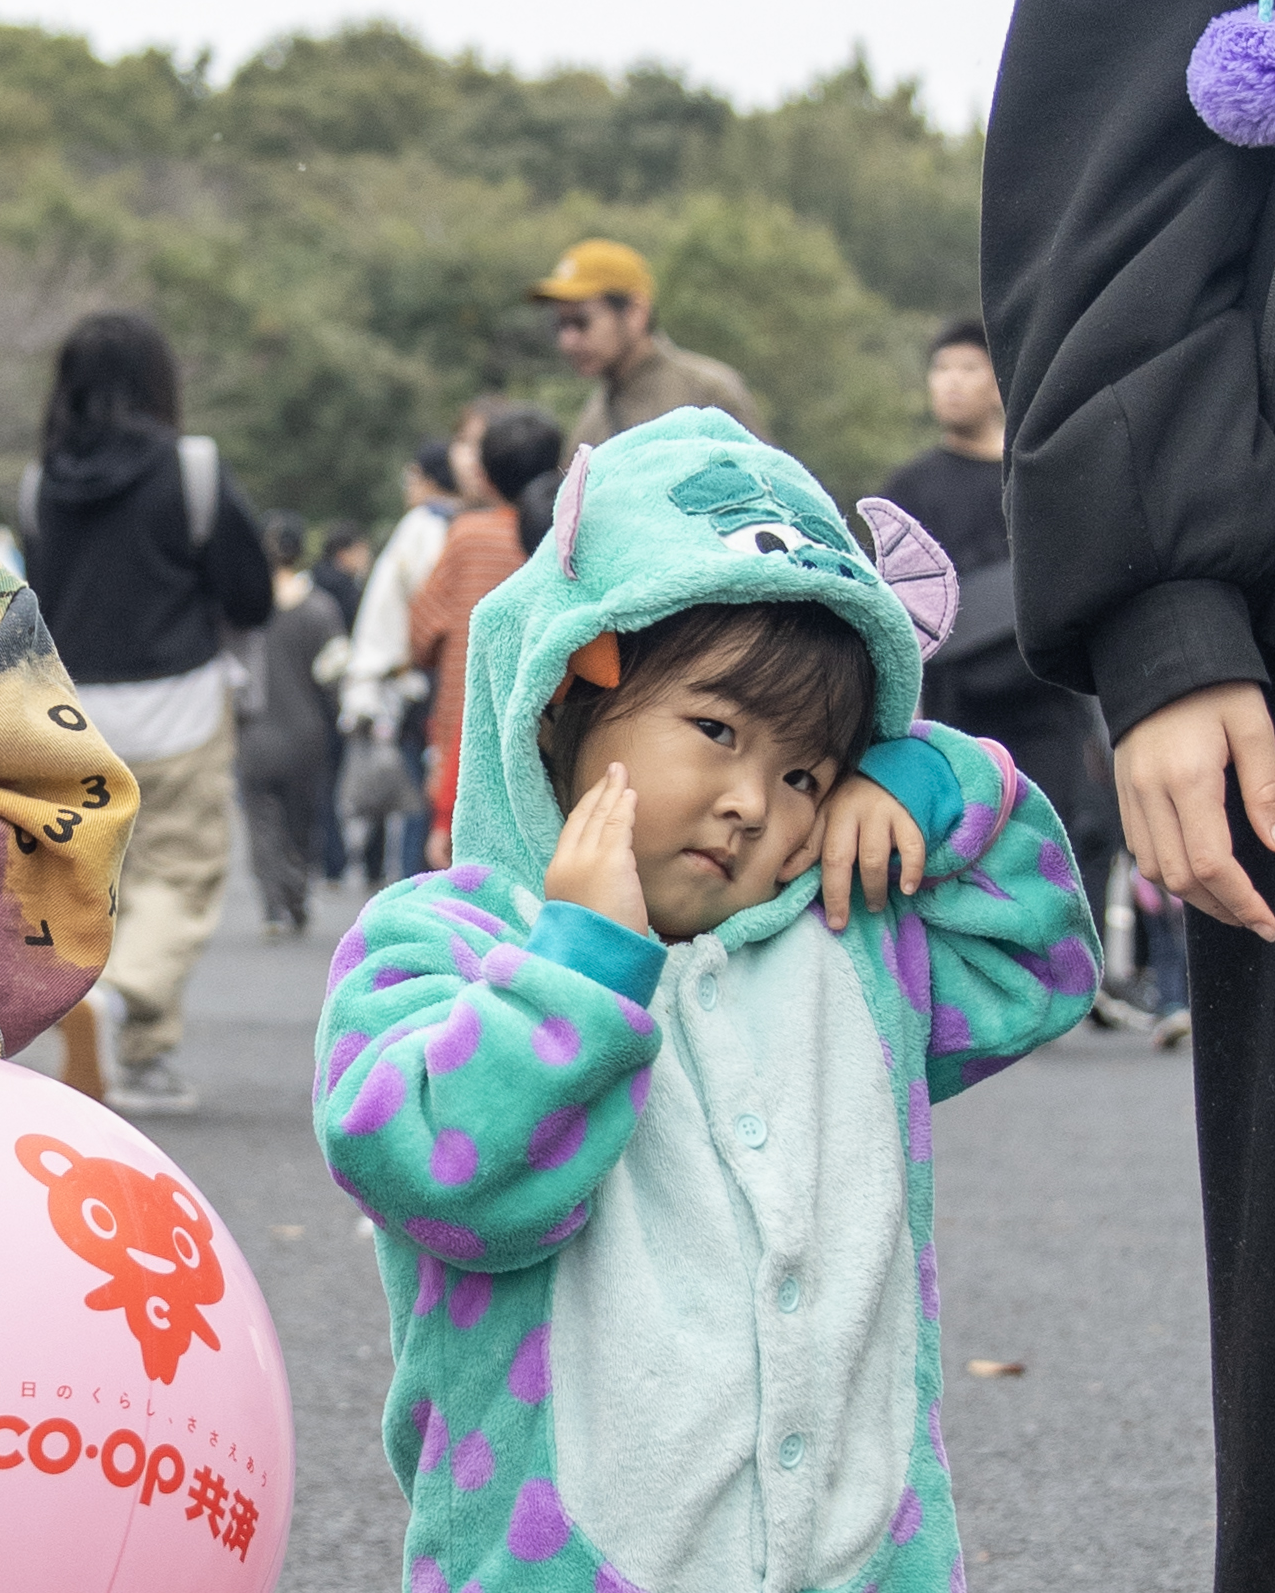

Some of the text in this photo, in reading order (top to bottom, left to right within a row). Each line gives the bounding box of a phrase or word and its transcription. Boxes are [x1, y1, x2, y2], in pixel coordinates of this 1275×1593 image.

[48, 704, 87, 731] 0
[80, 775, 111, 808] 3
[43, 809, 82, 843] 3
[145, 1295, 172, 1331] C
